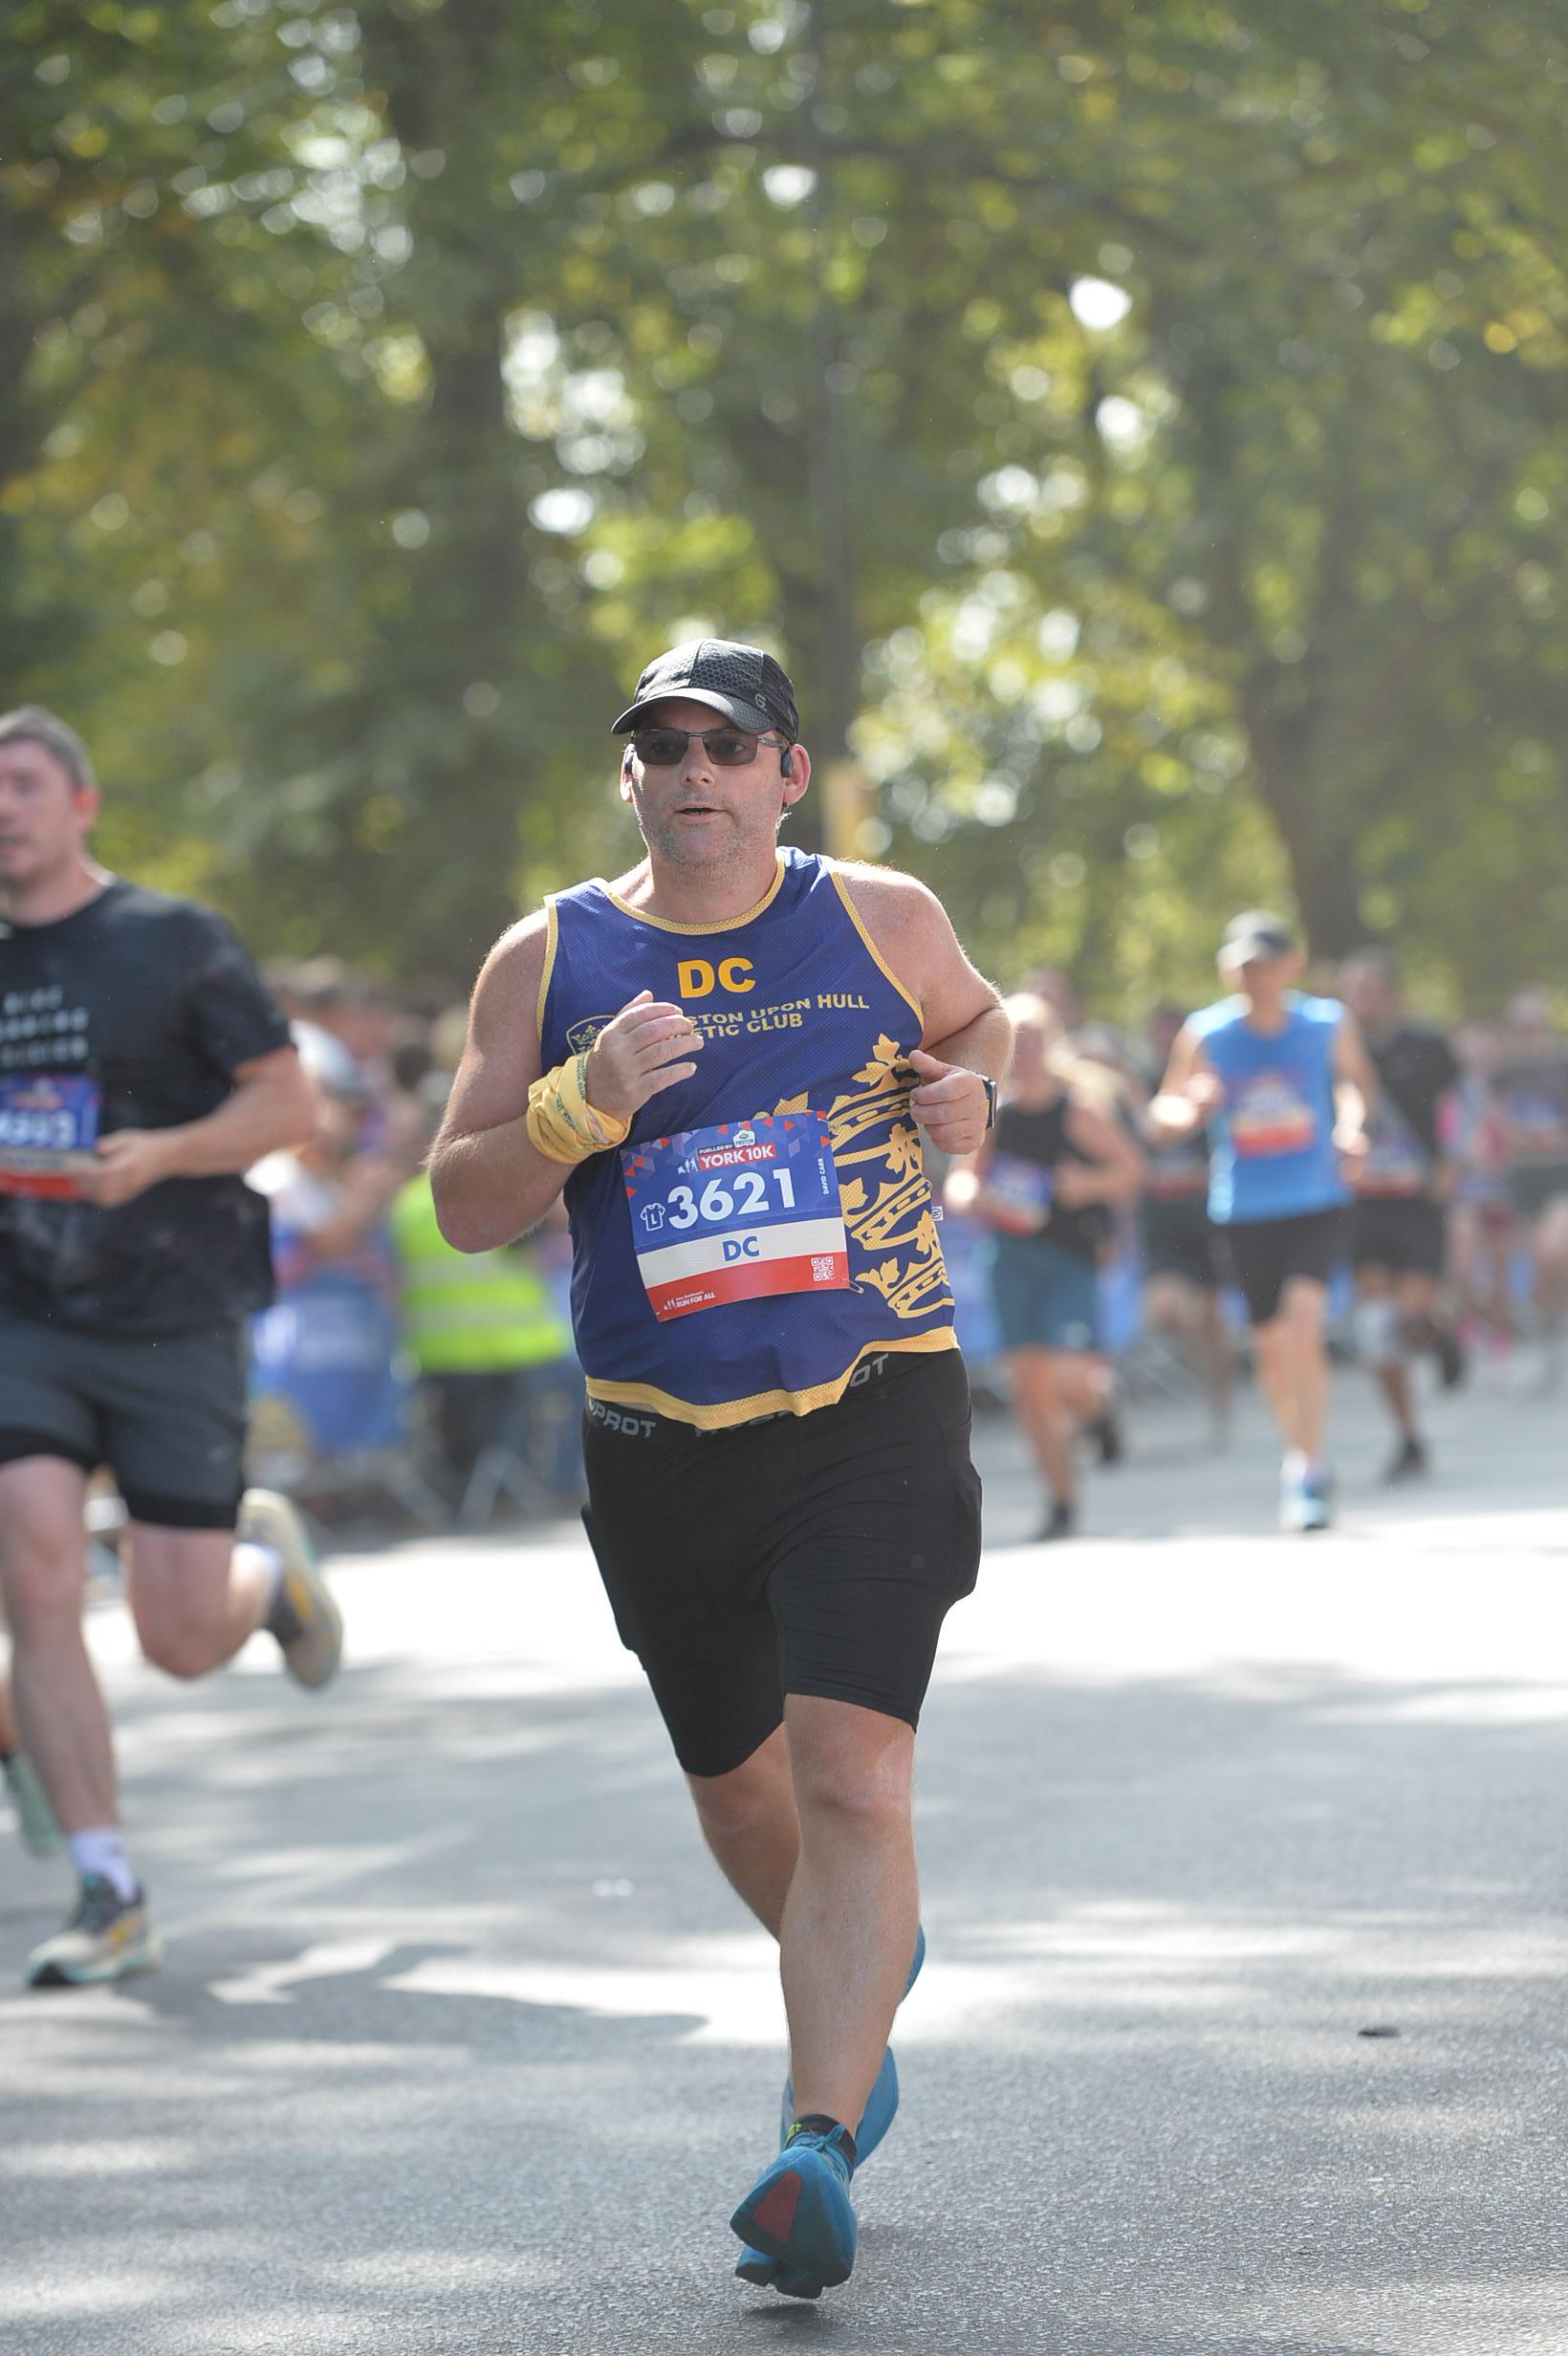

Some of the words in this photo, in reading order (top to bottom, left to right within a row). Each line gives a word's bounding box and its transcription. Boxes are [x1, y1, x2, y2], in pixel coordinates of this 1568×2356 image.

[677, 957, 755, 999] DC
[687, 1012, 743, 1026] STON
[751, 998, 811, 1019] UPON
[817, 993, 870, 1009] HULL
[691, 1024, 740, 1038] ETIC
[747, 1013, 803, 1033] CLUB
[701, 1150, 746, 1168] YORK
[746, 1145, 774, 1161] 10K
[817, 1158, 826, 1175] CARR
[820, 1175, 830, 1194] DAVID
[667, 1167, 795, 1230] 3621
[722, 1235, 760, 1262] DC
